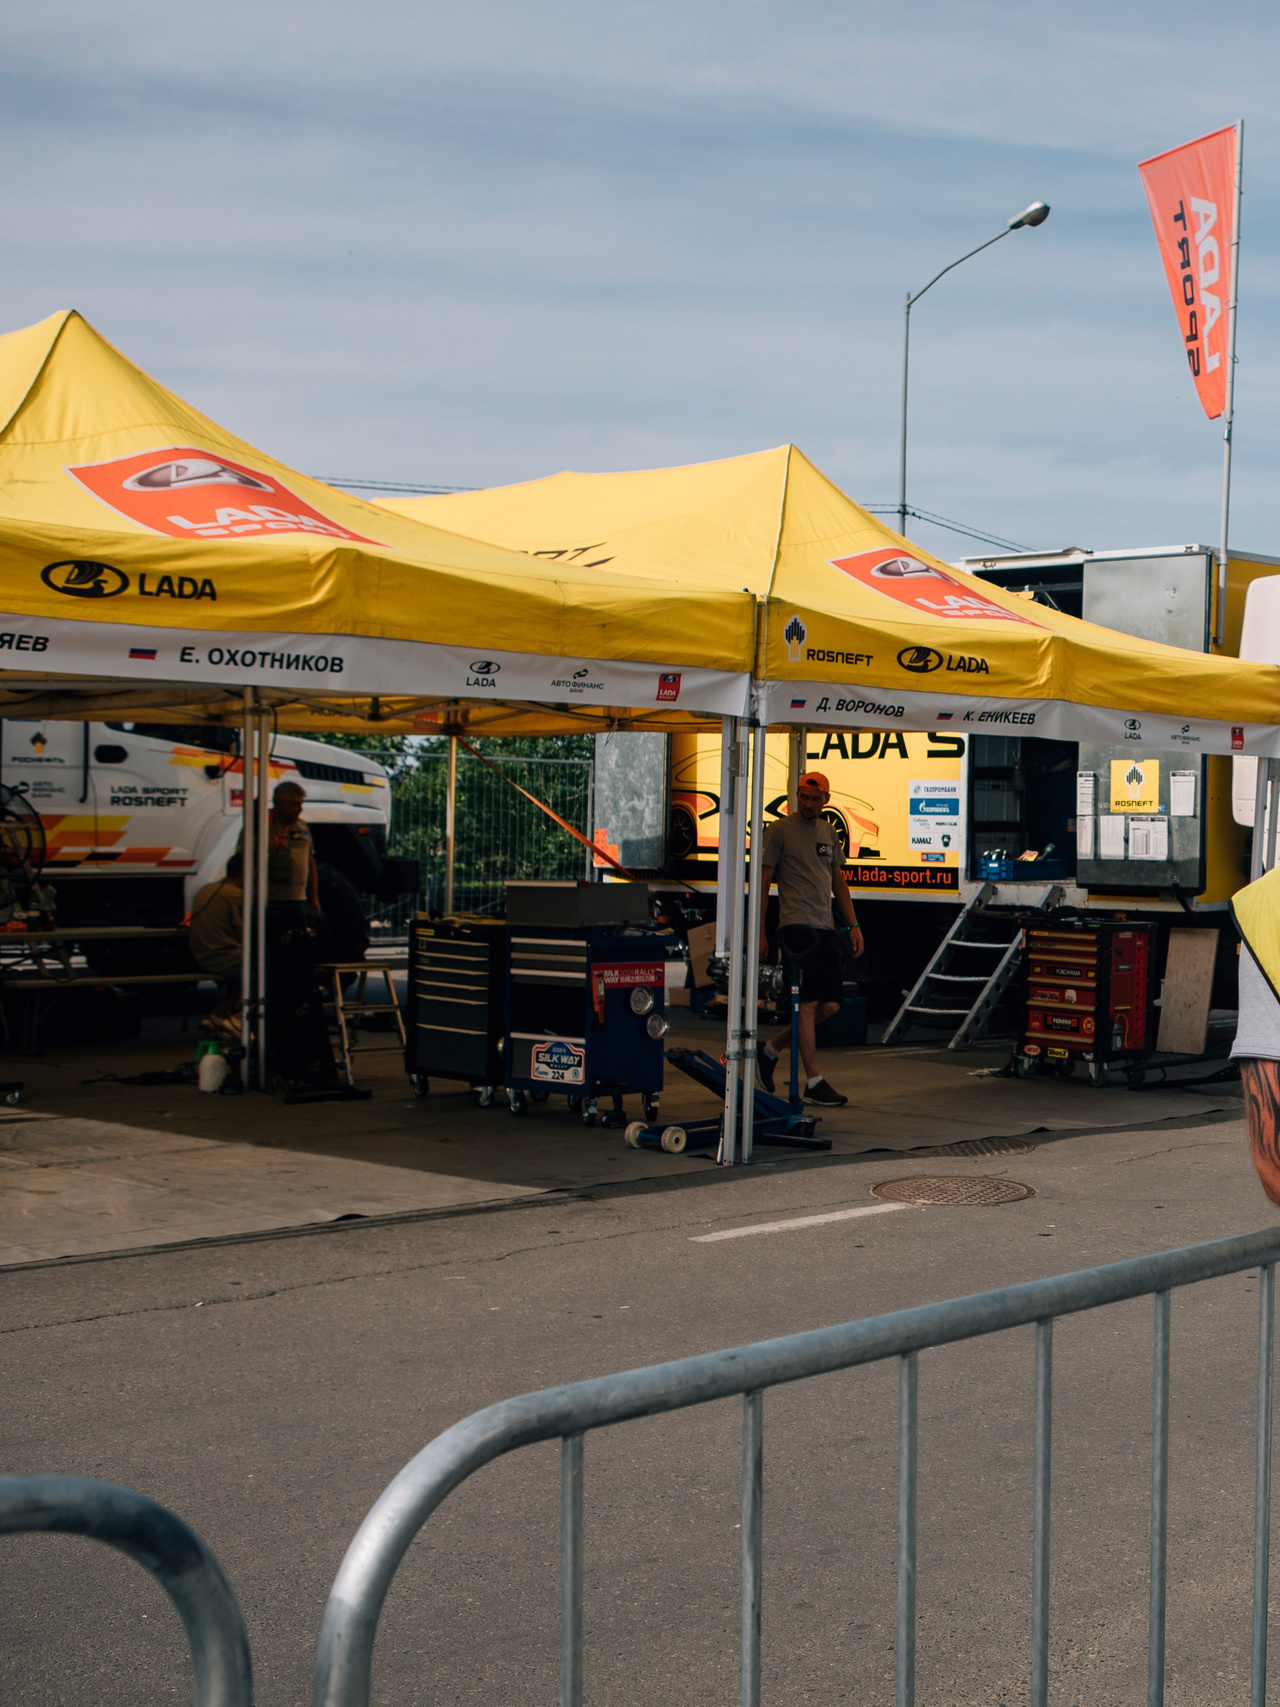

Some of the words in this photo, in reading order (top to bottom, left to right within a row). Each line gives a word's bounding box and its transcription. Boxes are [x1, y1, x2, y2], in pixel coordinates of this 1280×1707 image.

[165, 504, 332, 532] LADA
[138, 573, 217, 601] LADA
[179, 647, 200, 664] Е.
[207, 648, 344, 673] ОХОТНИКОВ
[806, 648, 874, 667] ROSNEFT
[946, 655, 990, 674] LADA
[465, 676, 496, 688] LADA
[816, 697, 831, 712] Д.
[835, 699, 905, 717] ВОРОНОВ
[962, 711, 975, 721] К.
[978, 711, 1036, 725] ЕНИКЕЕВ
[1124, 732, 1142, 740] LADA
[142, 786, 189, 795] SPORT
[110, 796, 189, 807] ROSNEFT
[911, 837, 932, 845] KAMAZ
[538, 1053, 560, 1063] SILK
[560, 1055, 580, 1065] WAY
[552, 1071, 565, 1080] 224
